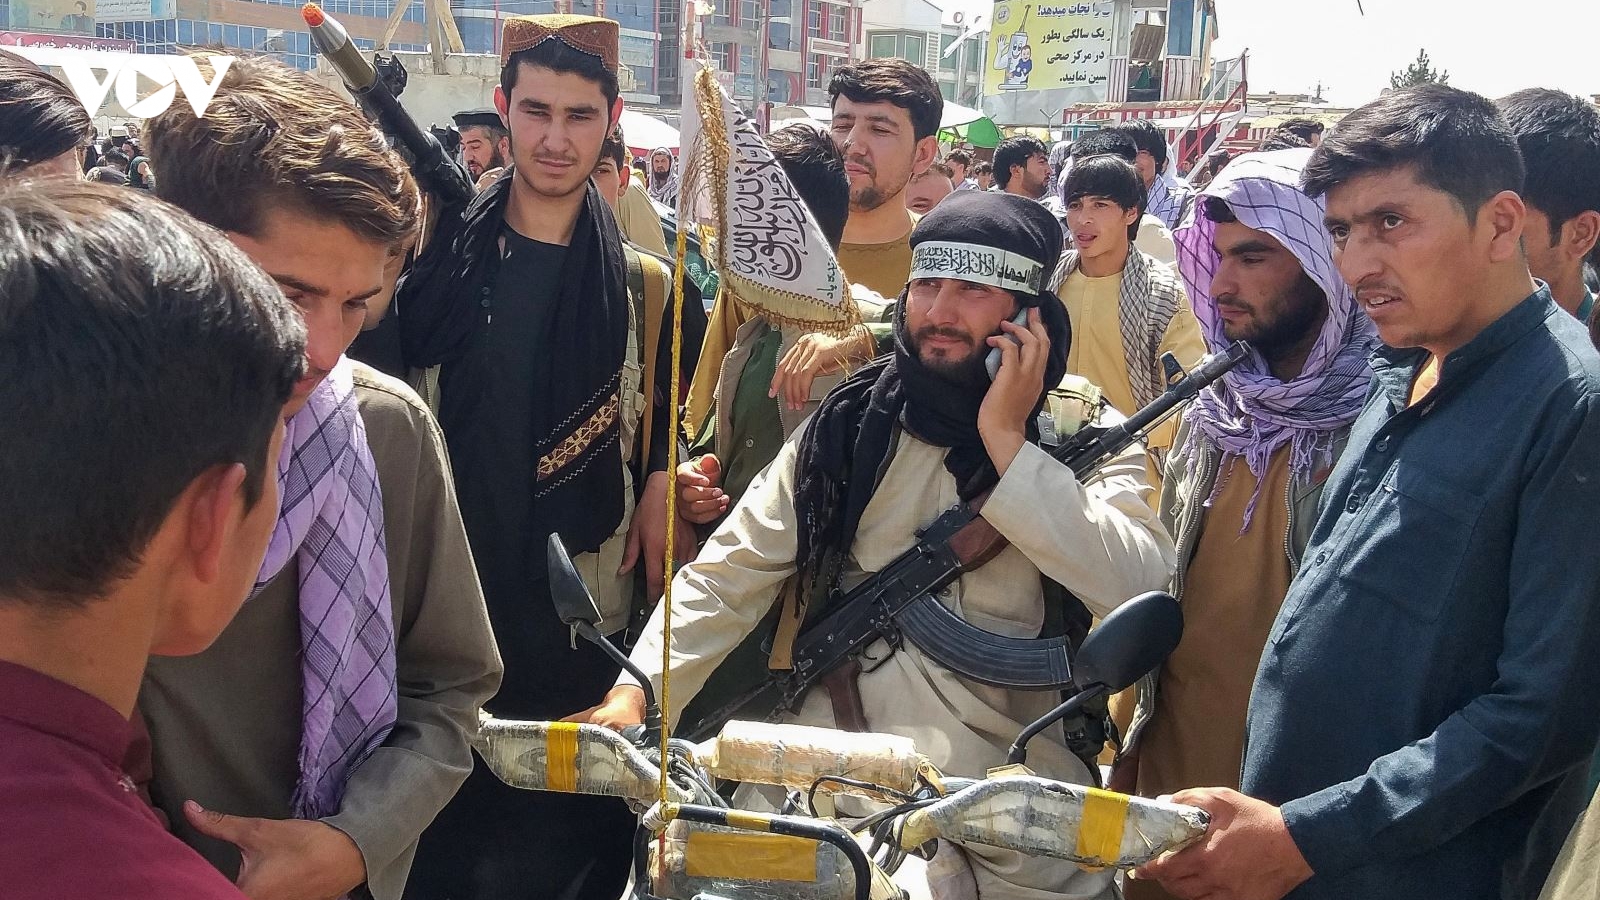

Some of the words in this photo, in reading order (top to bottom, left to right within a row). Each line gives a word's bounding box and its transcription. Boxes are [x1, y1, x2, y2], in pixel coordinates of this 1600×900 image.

[1068, 3, 1090, 17] نجات
[1041, 29, 1061, 44] بطور
[1062, 28, 1090, 42] سالگی
[1091, 28, 1105, 41] یک
[1047, 52, 1070, 65] صحی
[1071, 50, 1092, 64] مرکز
[1094, 51, 1105, 63] در
